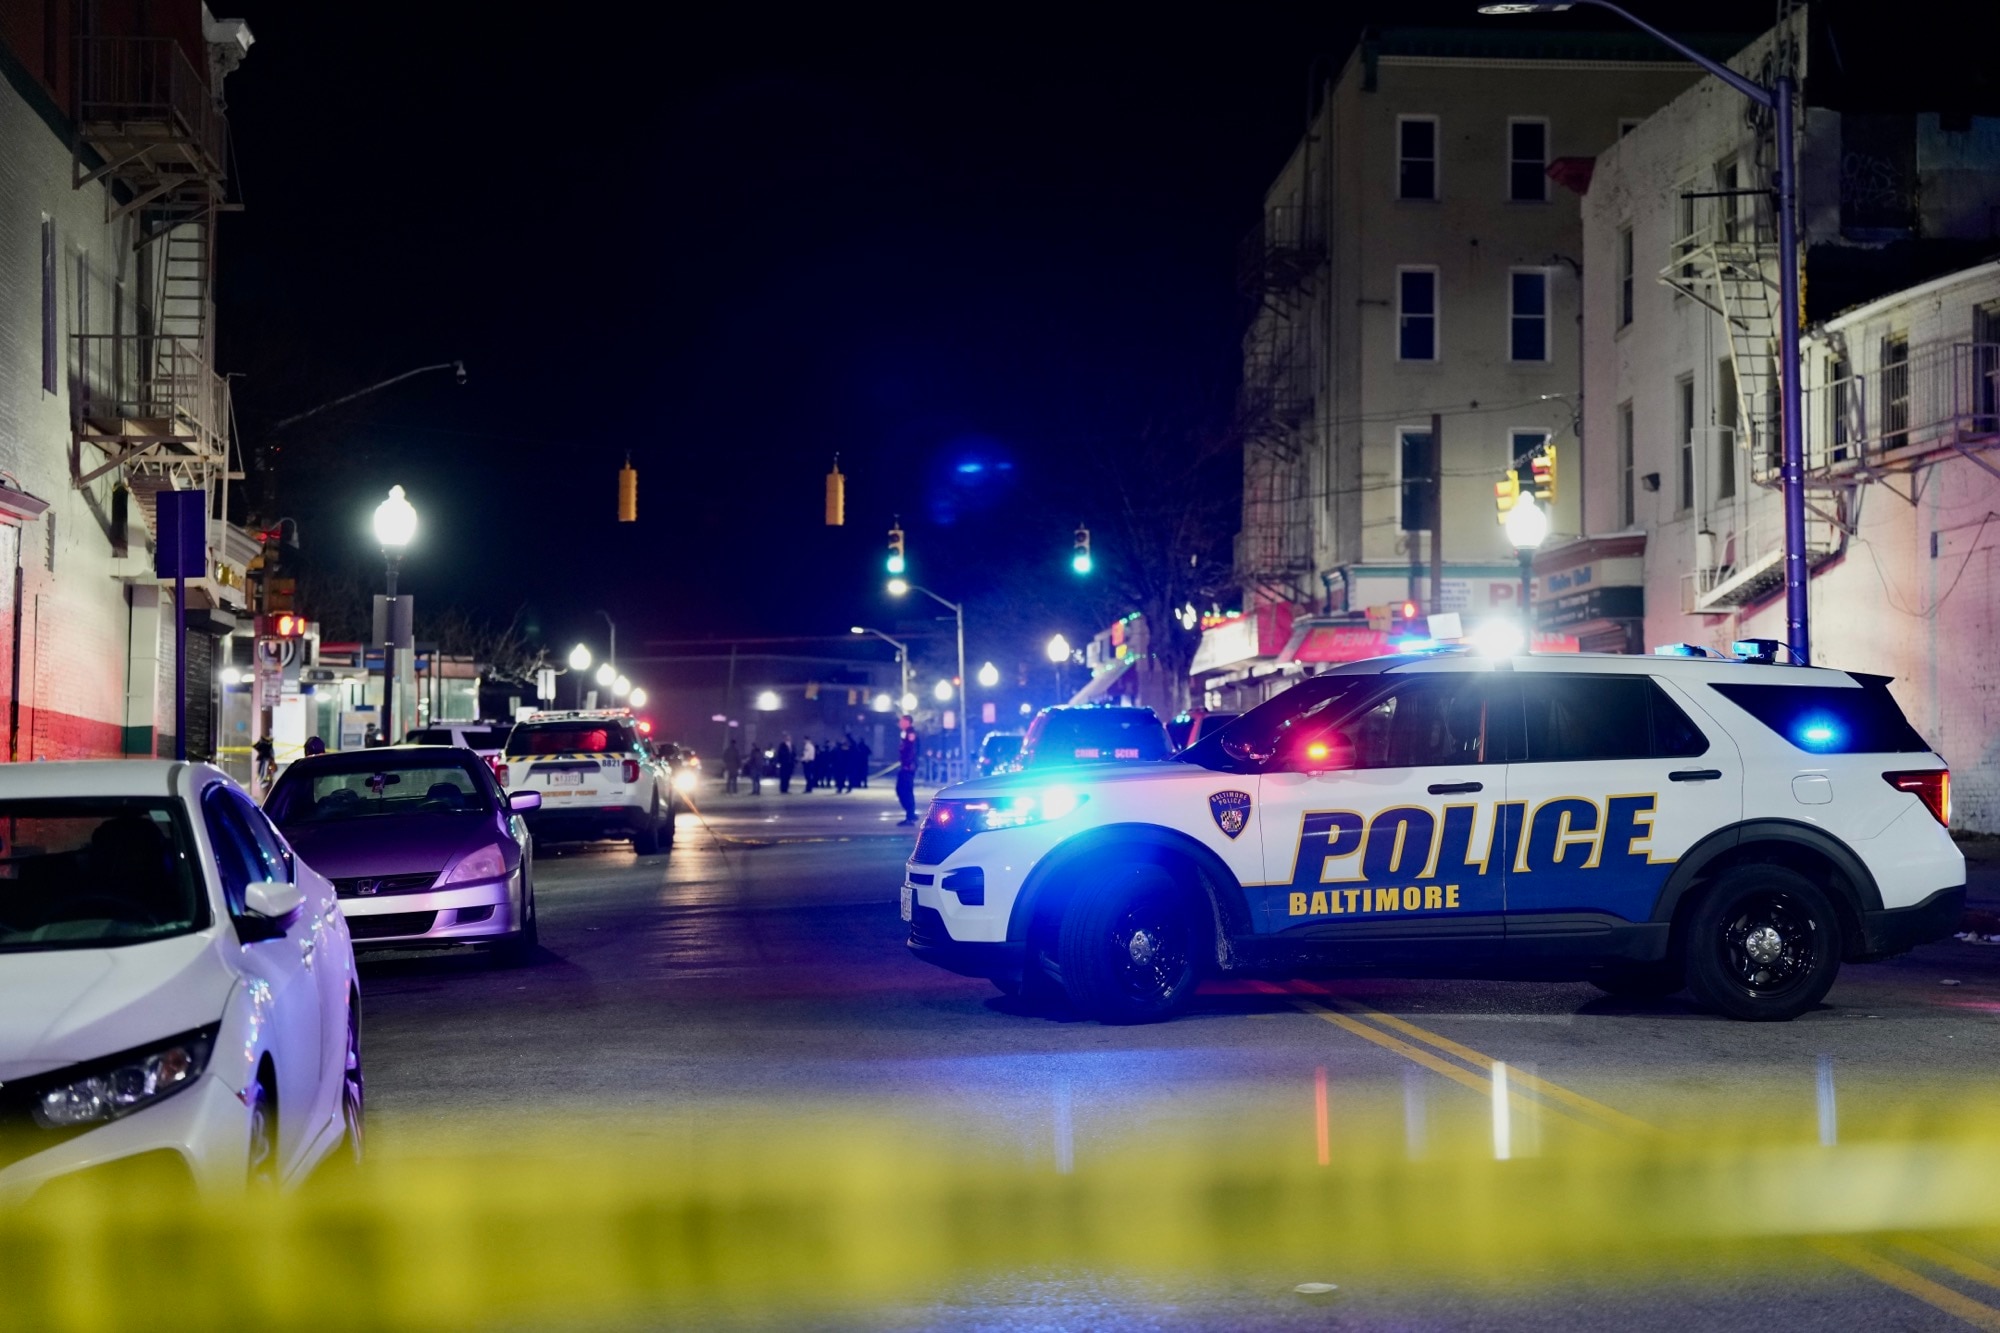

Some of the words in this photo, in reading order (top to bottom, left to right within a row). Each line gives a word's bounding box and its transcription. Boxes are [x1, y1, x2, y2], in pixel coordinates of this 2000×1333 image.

[1211, 792, 1248, 802] BALTIMORE
[1219, 798, 1241, 806] POLICE
[1292, 792, 1659, 884] POLICE
[1289, 885, 1460, 916] BALTIMORE
